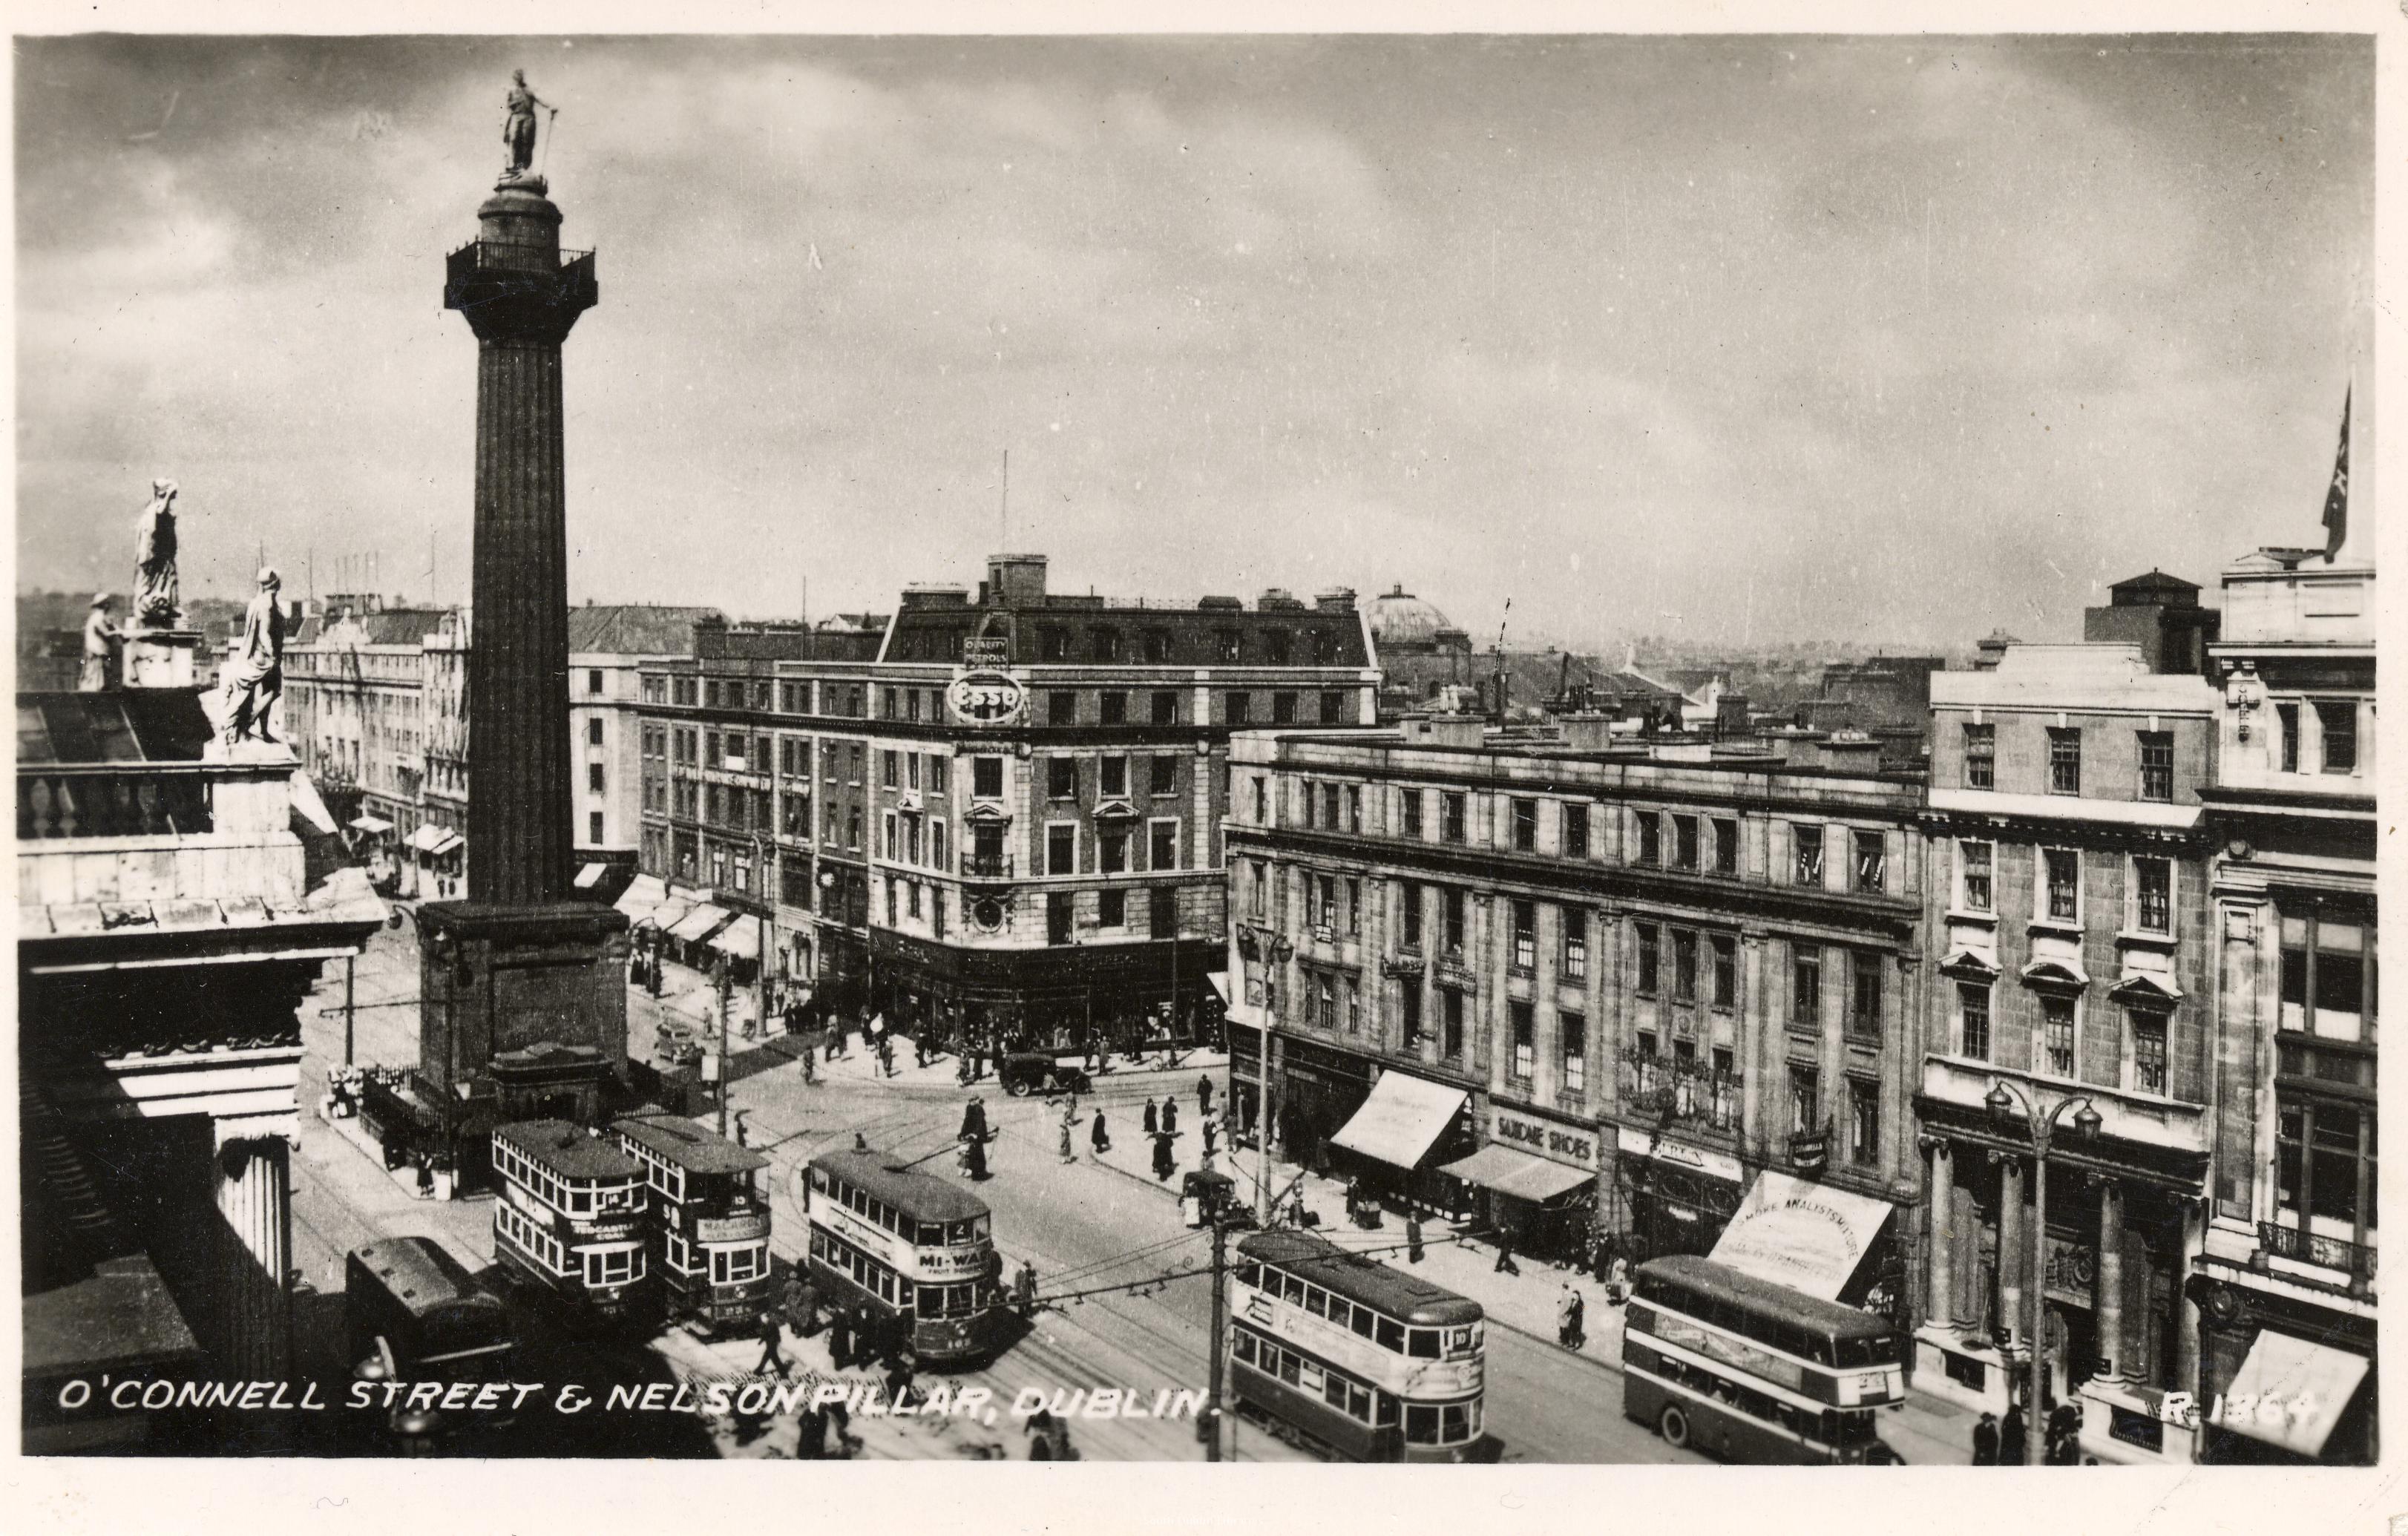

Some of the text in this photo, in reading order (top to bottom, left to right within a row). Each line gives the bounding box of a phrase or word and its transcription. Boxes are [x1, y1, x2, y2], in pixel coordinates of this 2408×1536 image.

[965, 640, 1005, 649] QUALITY
[956, 1225, 965, 1235] 2
[1455, 1332, 1466, 1345] 10
